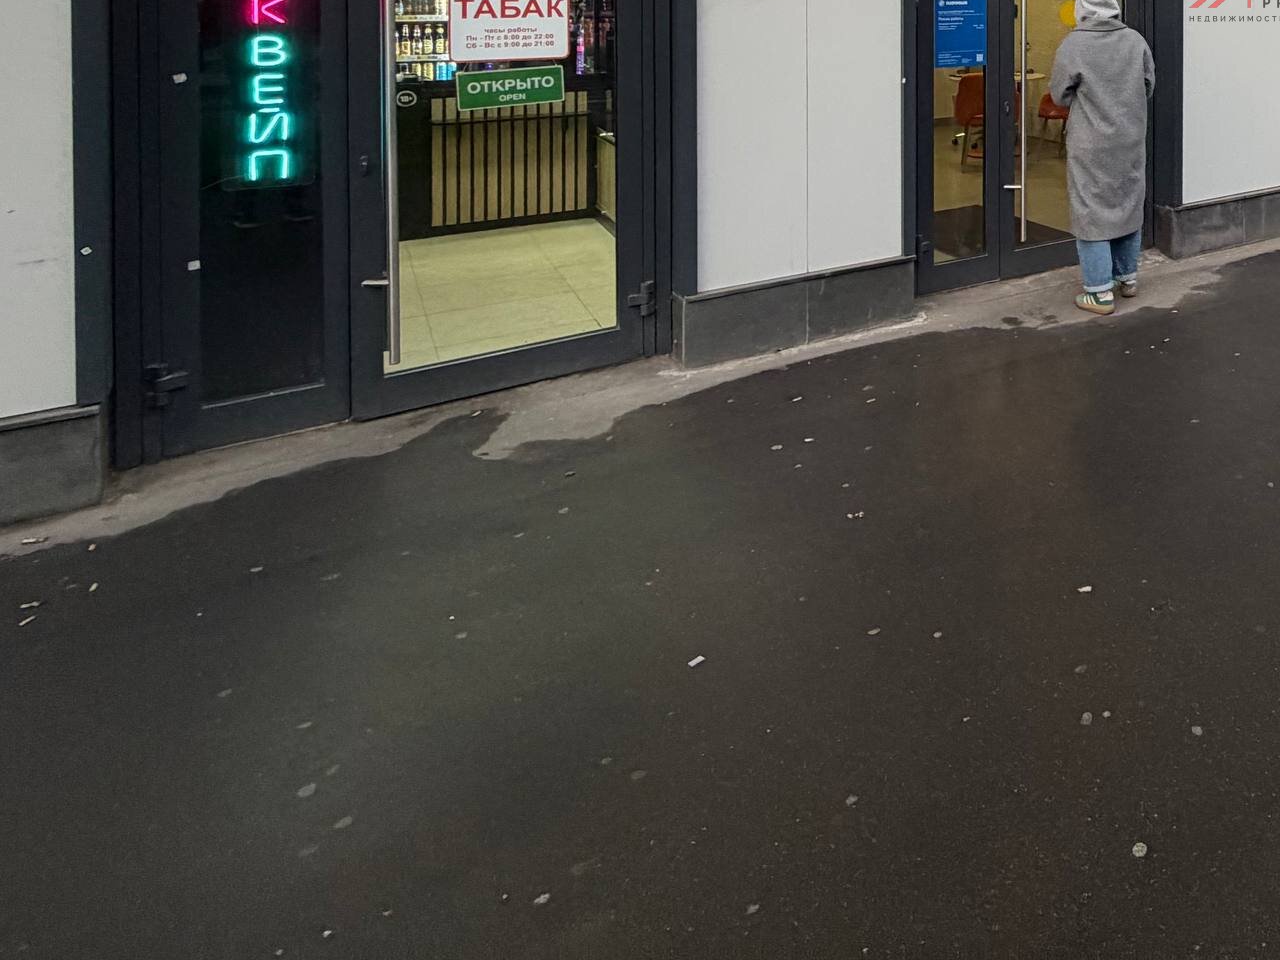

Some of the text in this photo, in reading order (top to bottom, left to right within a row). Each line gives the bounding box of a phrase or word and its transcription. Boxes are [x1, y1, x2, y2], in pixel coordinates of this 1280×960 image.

[467, 75, 555, 94] ОТКРЫТО
[498, 93, 526, 102] OPEN
[249, 34, 290, 181] ВЕЙП
